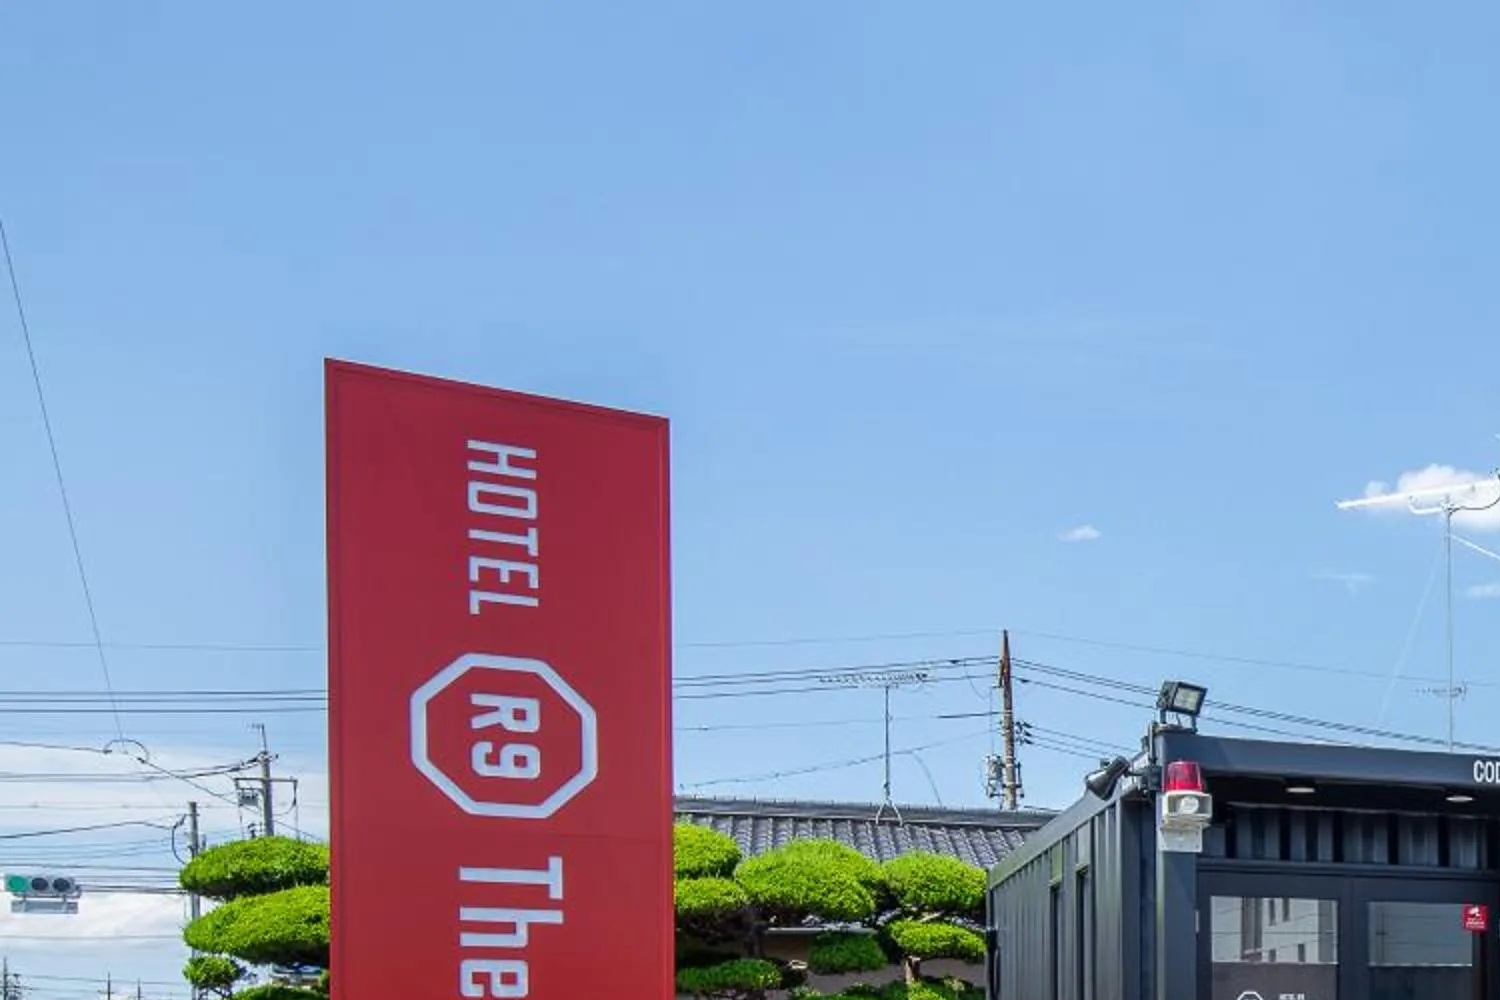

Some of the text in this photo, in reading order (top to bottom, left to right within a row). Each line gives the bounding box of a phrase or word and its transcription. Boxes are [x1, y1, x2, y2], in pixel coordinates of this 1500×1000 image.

[467, 439, 539, 615] HOTEL
[471, 693, 541, 780] R9
[459, 856, 564, 998] The
